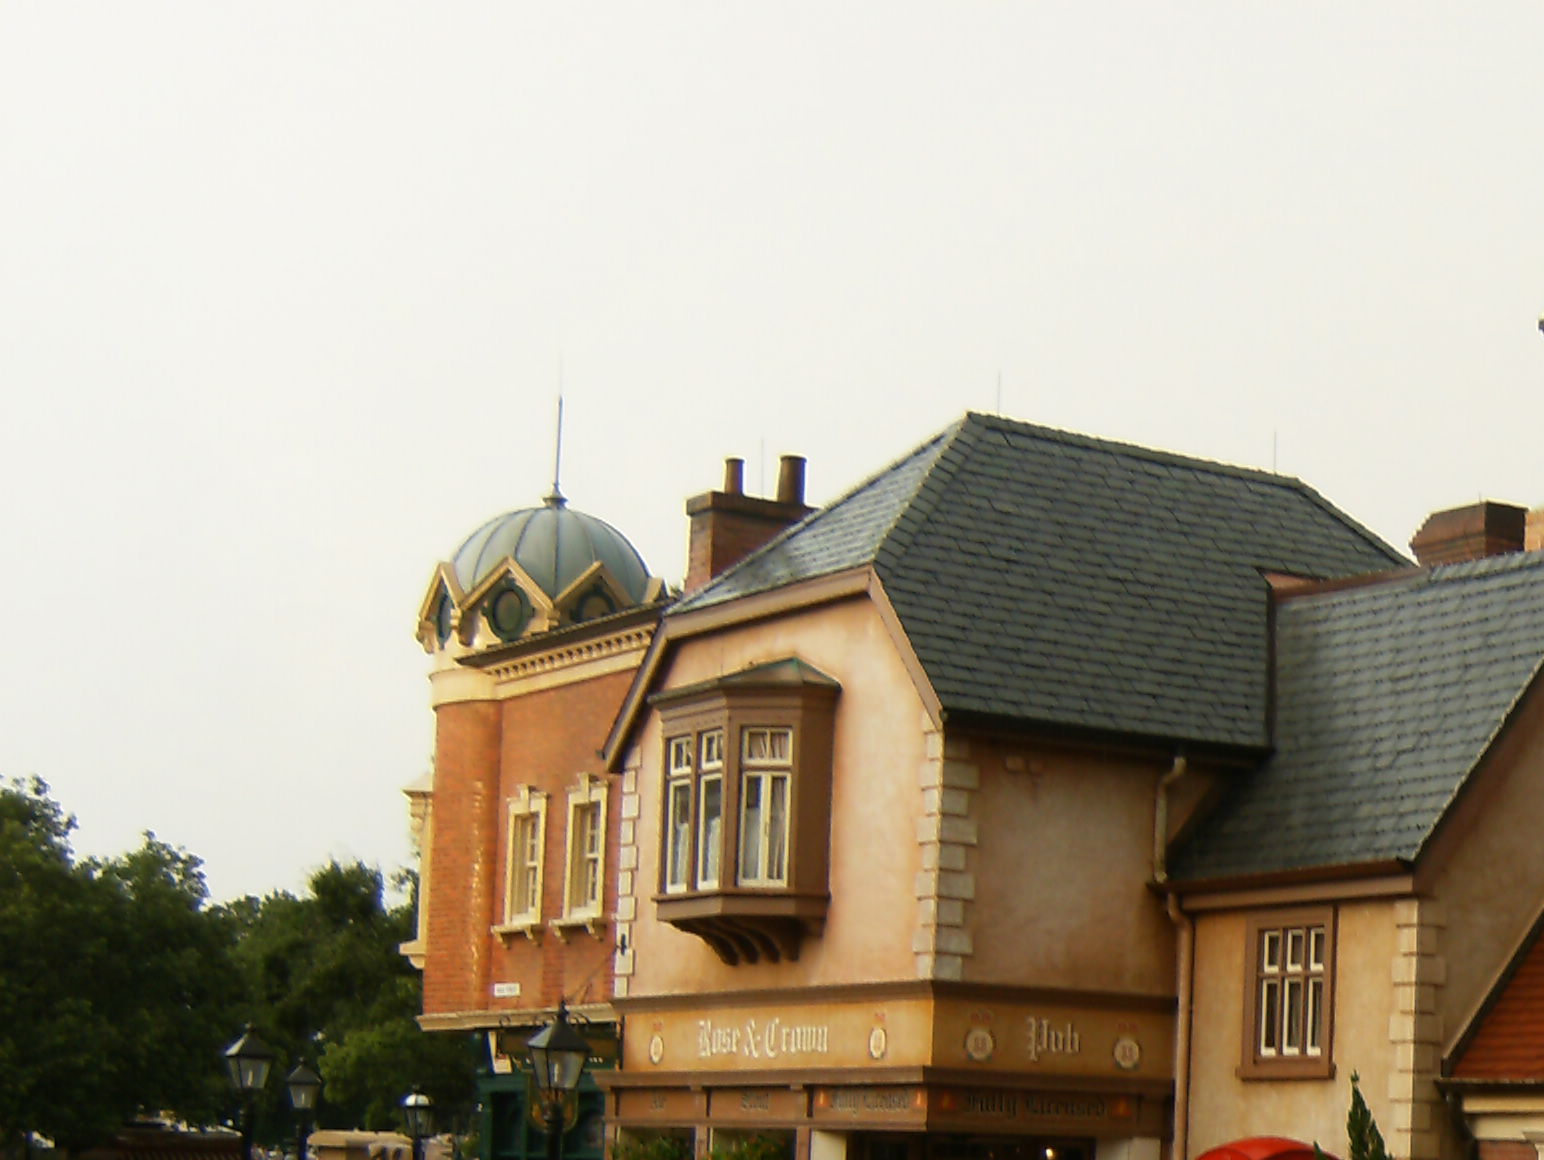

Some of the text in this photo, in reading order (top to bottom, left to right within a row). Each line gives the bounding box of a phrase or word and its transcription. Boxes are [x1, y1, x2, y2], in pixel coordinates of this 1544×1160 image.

[698, 1018, 740, 1057] Rose
[764, 1017, 829, 1058] Crown
[1027, 1016, 1080, 1062] Pub
